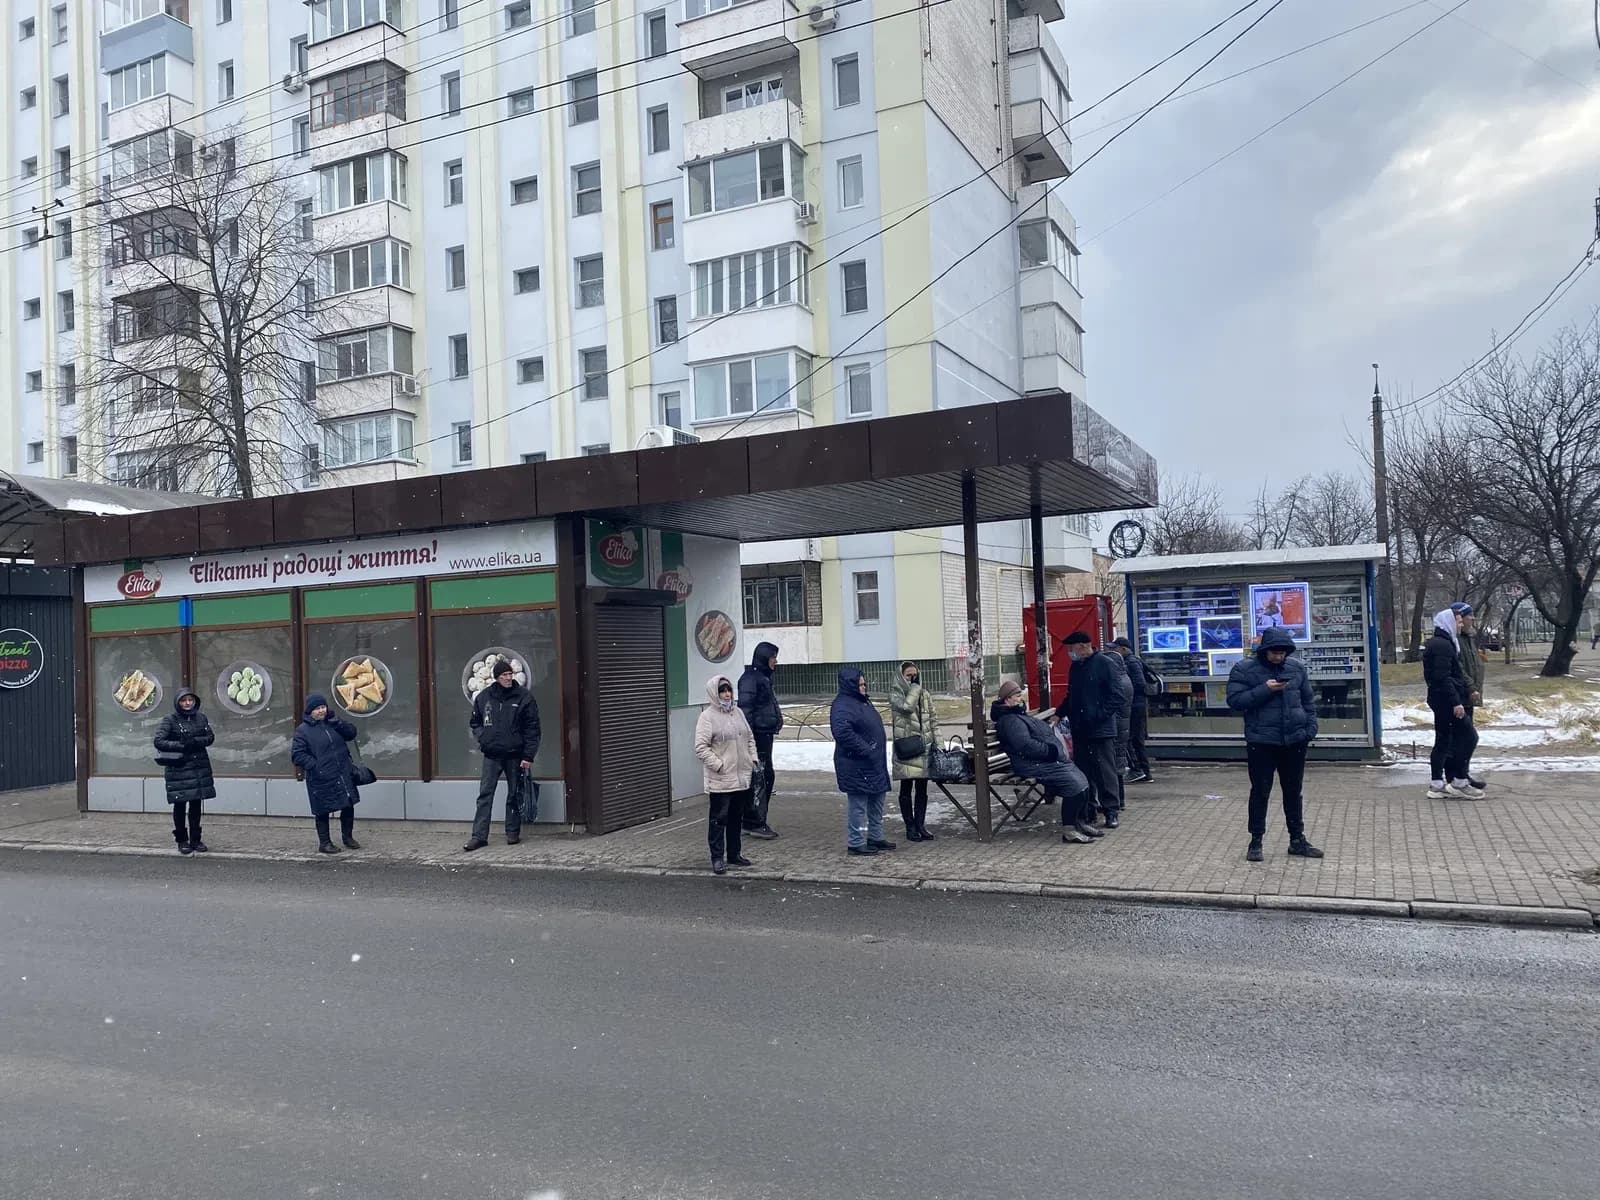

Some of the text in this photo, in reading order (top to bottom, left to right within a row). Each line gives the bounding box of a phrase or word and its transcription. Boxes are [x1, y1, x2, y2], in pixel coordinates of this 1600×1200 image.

[607, 538, 633, 561] Elika
[272, 549, 342, 583] радощі
[347, 539, 438, 571] життя!
[449, 551, 542, 570] www.elika.ua
[124, 574, 155, 594] Elika
[0, 640, 37, 656] treet
